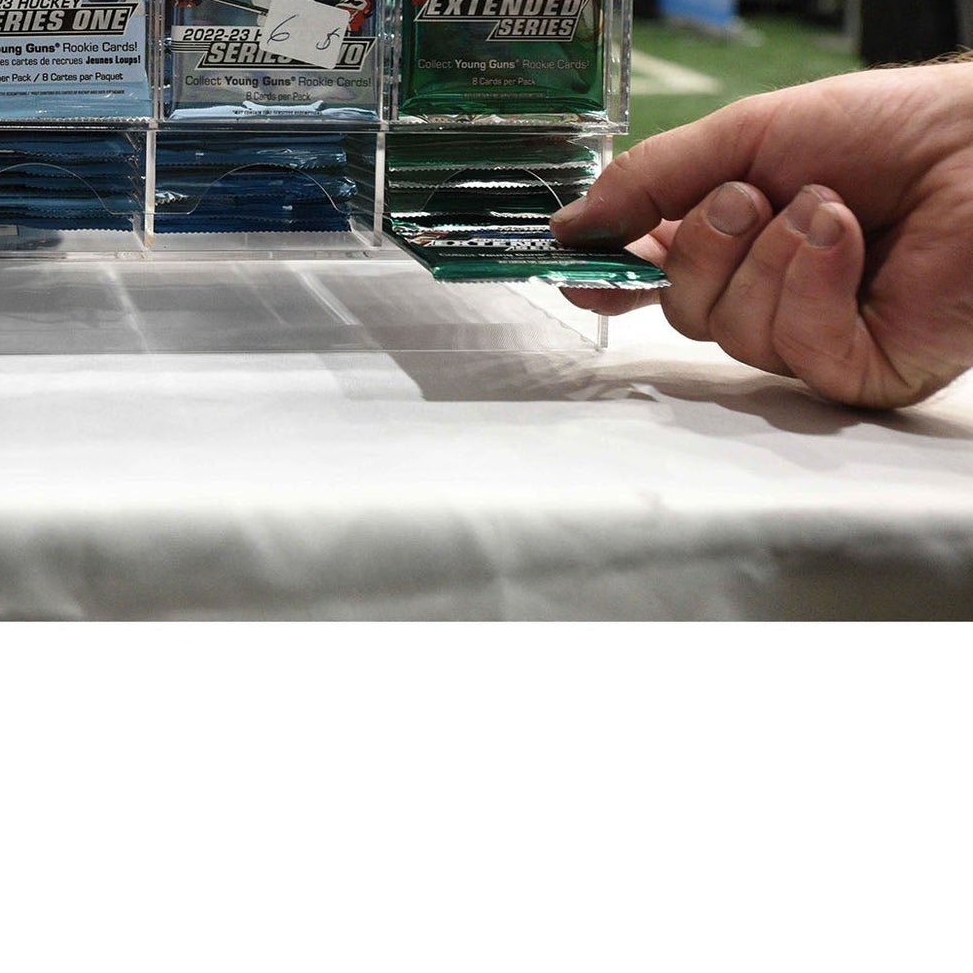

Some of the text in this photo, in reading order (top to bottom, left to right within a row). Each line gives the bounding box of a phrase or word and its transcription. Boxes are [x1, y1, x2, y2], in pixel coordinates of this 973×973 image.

[72, 8, 128, 31] ONE
[498, 18, 575, 37] SERIES
[182, 28, 250, 42] 2022-23
[63, 42, 99, 53] Rookie
[101, 41, 138, 52] Cards!
[11, 58, 38, 66] cartes
[39, 57, 50, 66] de
[52, 58, 83, 66] recrues
[85, 56, 113, 65] Jeunes
[115, 55, 141, 66] Loups!
[418, 58, 452, 69] Collect
[455, 59, 486, 71] Young
[522, 59, 555, 69] Rookie
[12, 73, 31, 82] Pack
[42, 73, 48, 82] 8
[50, 72, 78, 82] Cartes
[79, 74, 94, 84] par
[95, 72, 124, 83] Paquet
[185, 75, 221, 86] Collect
[224, 76, 258, 88] Young
[298, 77, 334, 87] Rookie
[336, 77, 372, 87] Cards!
[472, 77, 536, 88] 8 Cards per Pack
[254, 92, 277, 101] Cards
[278, 93, 292, 103] per
[293, 92, 311, 101] Pack
